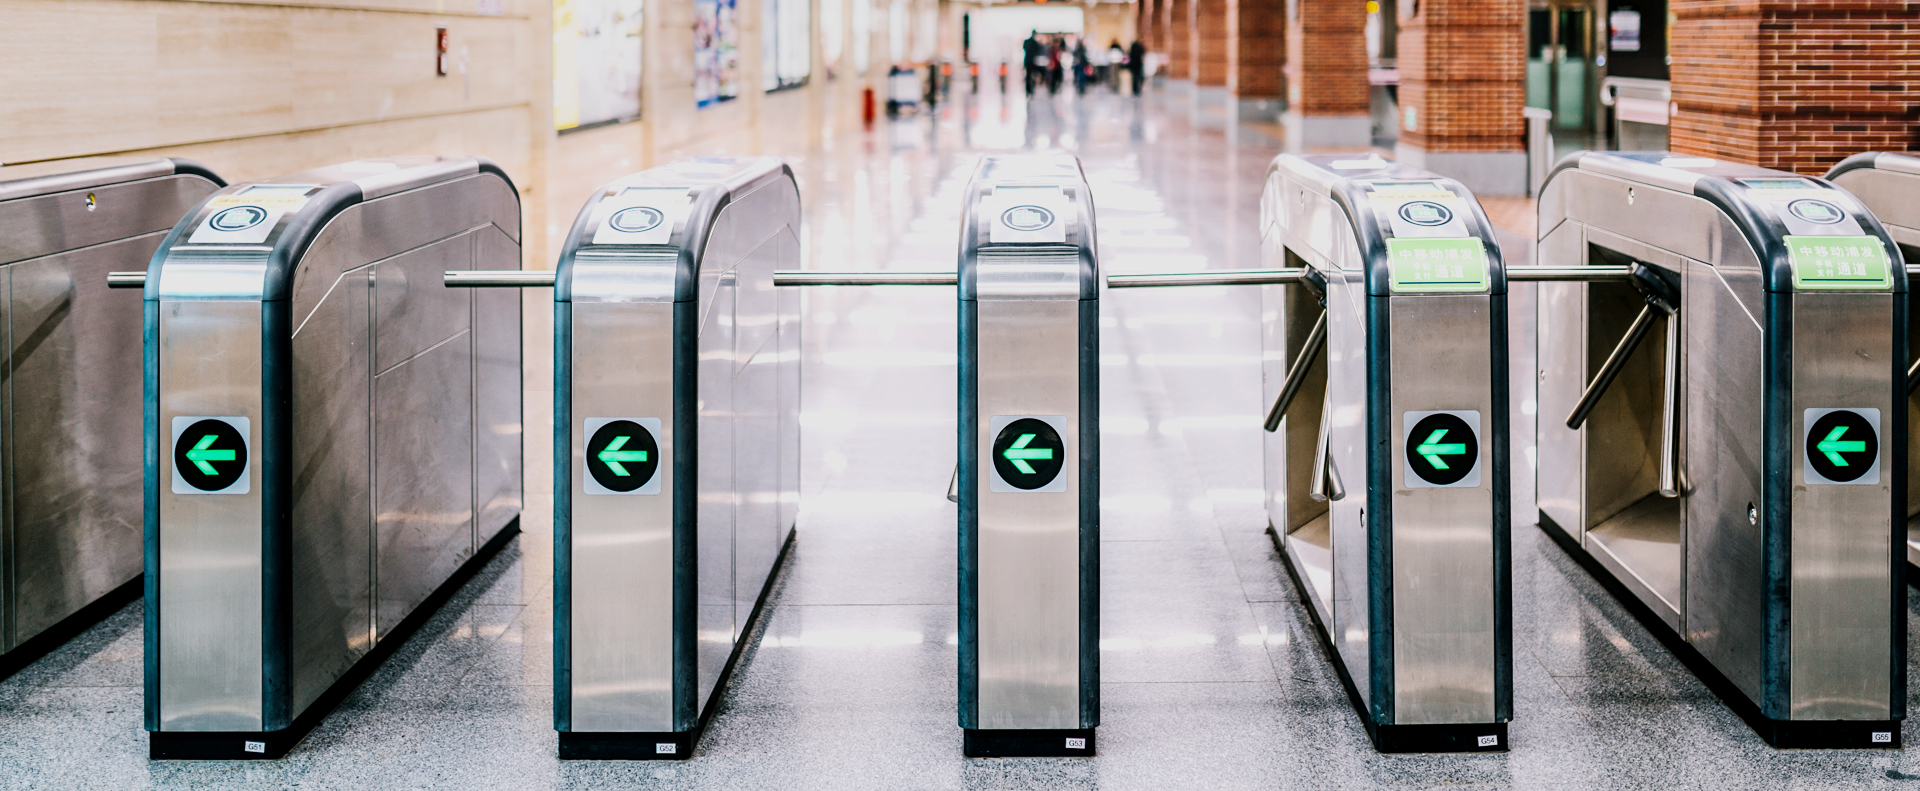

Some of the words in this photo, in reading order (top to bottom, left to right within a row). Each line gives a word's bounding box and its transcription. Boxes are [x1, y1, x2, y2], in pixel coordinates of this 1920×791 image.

[1435, 264, 1464, 279] 通道
[1837, 262, 1867, 276] 通道
[1480, 737, 1495, 745] G54
[1875, 733, 1889, 741] G55
